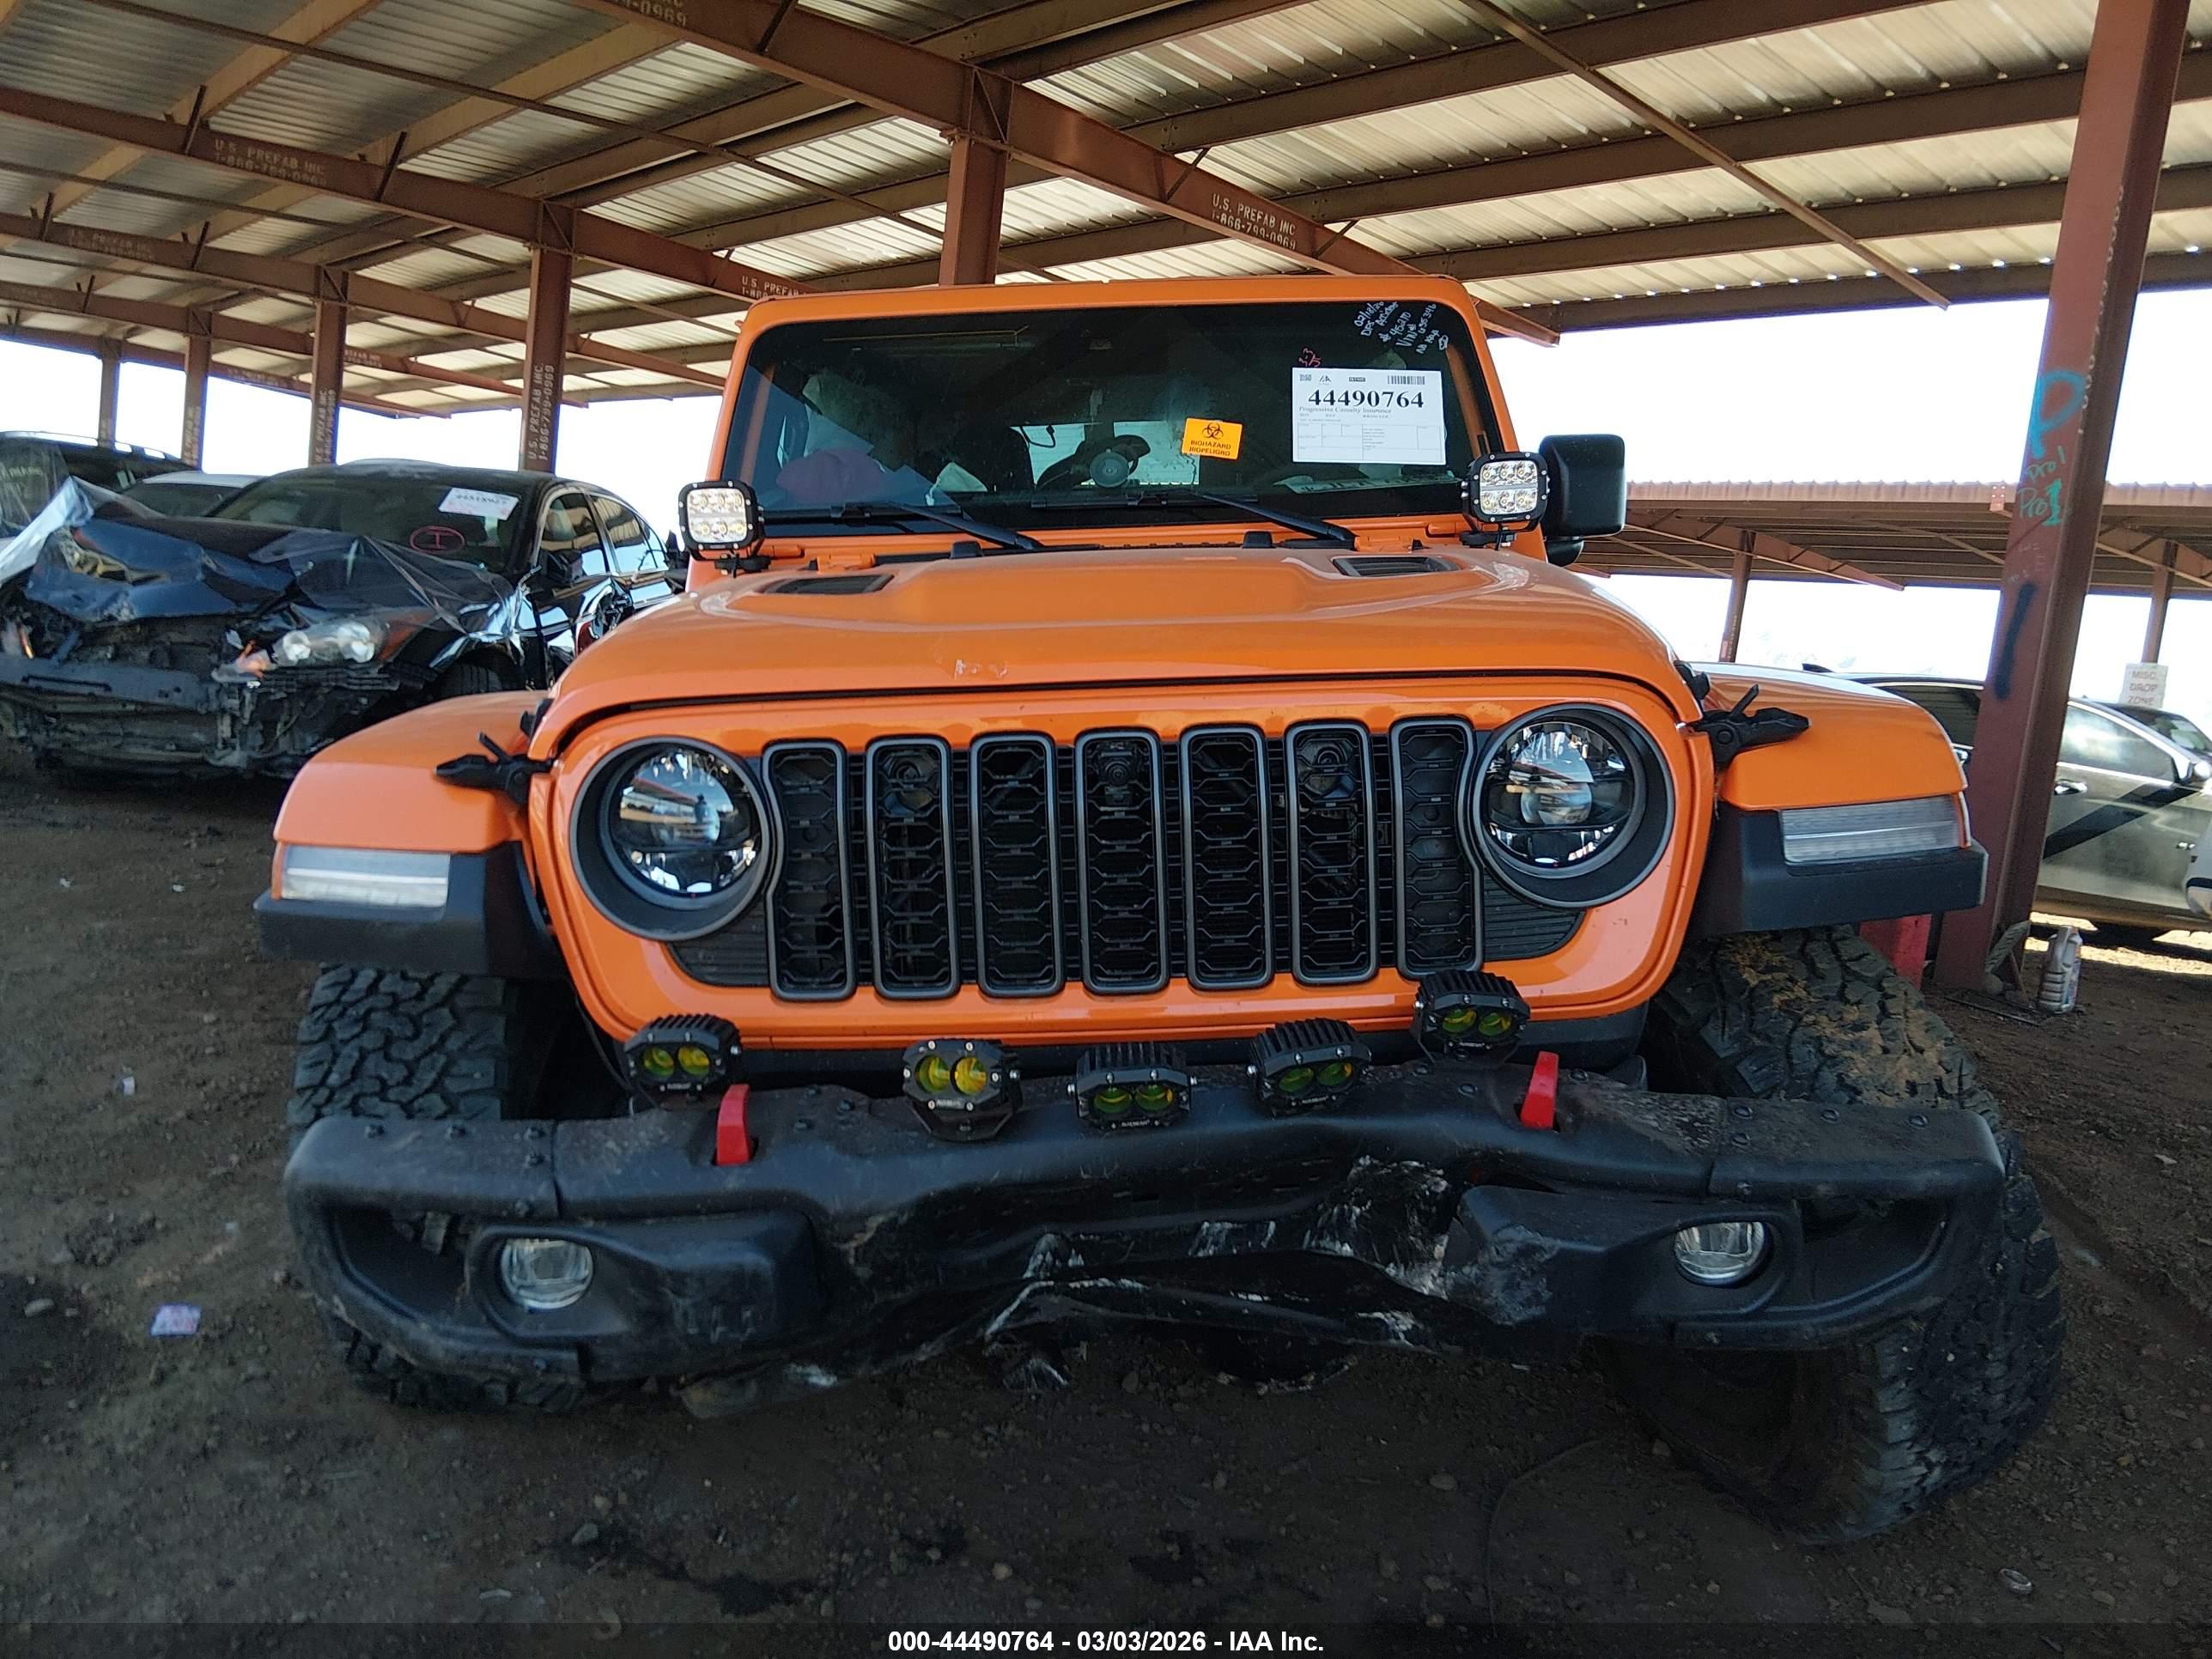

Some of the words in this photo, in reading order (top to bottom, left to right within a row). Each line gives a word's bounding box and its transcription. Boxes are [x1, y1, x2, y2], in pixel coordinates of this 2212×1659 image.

[1212, 193, 1232, 213] U.S.
[1237, 203, 1276, 228] PREFAB
[1279, 219, 1296, 236] INC
[1212, 210, 1296, 251] 1-866-799-0969
[742, 275, 760, 289] U.S.
[1360, 319, 1375, 337] DPS
[1308, 389, 1424, 408] 44490764
[529, 388, 543, 434] PREFAB
[527, 438, 539, 460] U.S.
[1189, 447, 1231, 456] BIOPELIGRO
[1190, 440, 1231, 450] BIOHAZARD
[2130, 683, 2158, 692] DROP
[2129, 696, 2154, 706] ZONE
